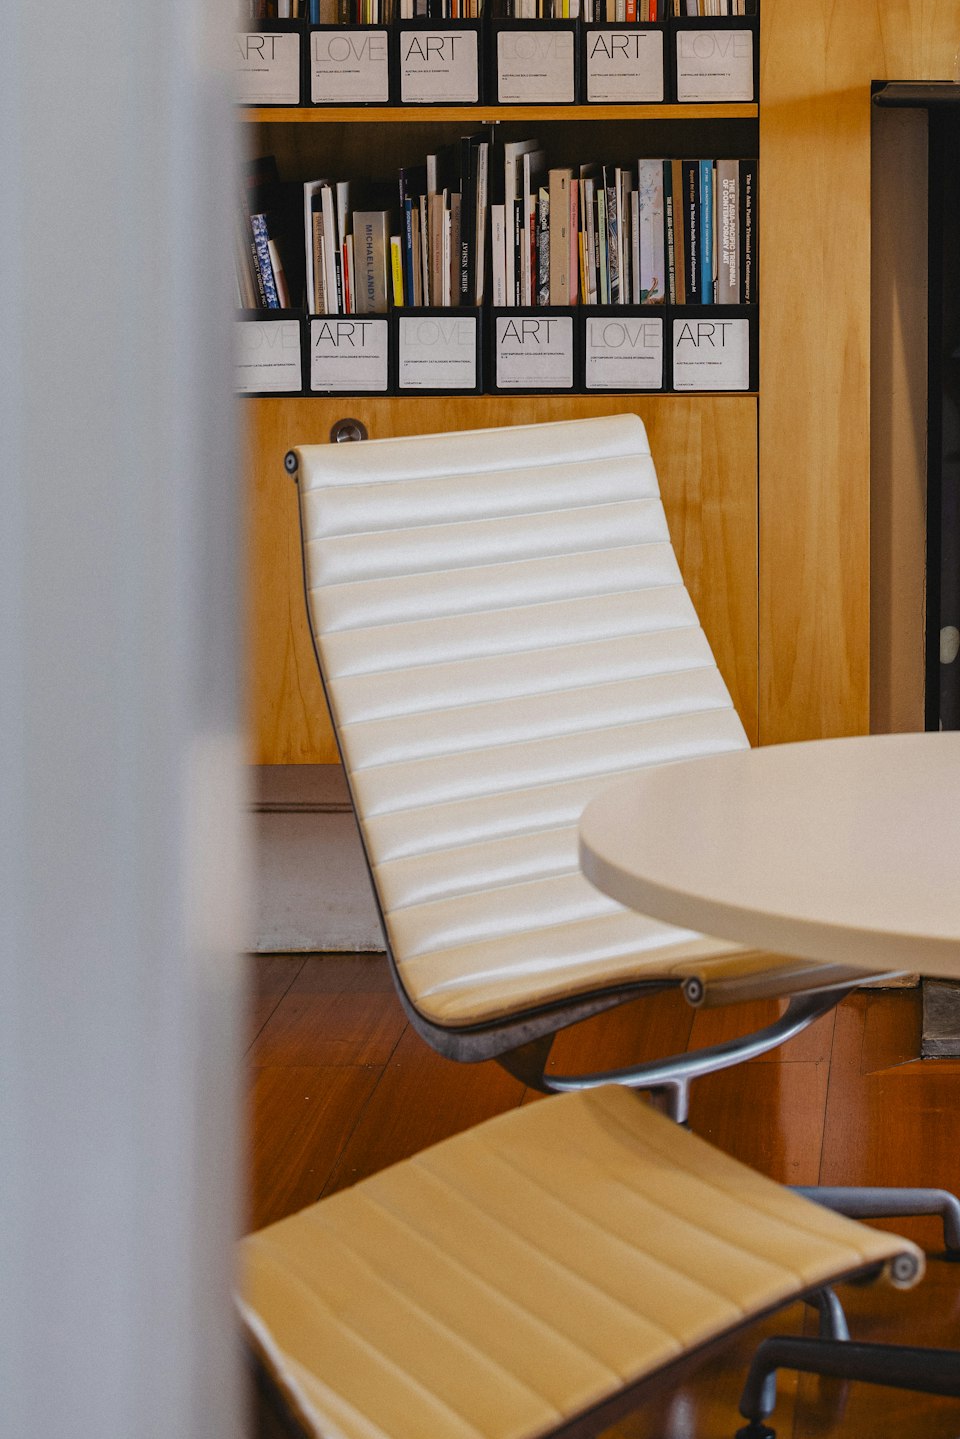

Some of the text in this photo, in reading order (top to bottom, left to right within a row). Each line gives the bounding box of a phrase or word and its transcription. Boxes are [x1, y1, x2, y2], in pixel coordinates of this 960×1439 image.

[314, 36, 386, 63] LOVE
[405, 36, 462, 62] ART
[590, 34, 647, 59] ART
[679, 33, 750, 59] LOVE
[365, 224, 375, 301] MICHAEL LANDY
[241, 323, 299, 349] OVE
[315, 322, 373, 348] ART
[403, 320, 474, 347] LOVE
[500, 319, 558, 344] ART
[590, 323, 660, 348] LOVE
[676, 322, 733, 348] ART
